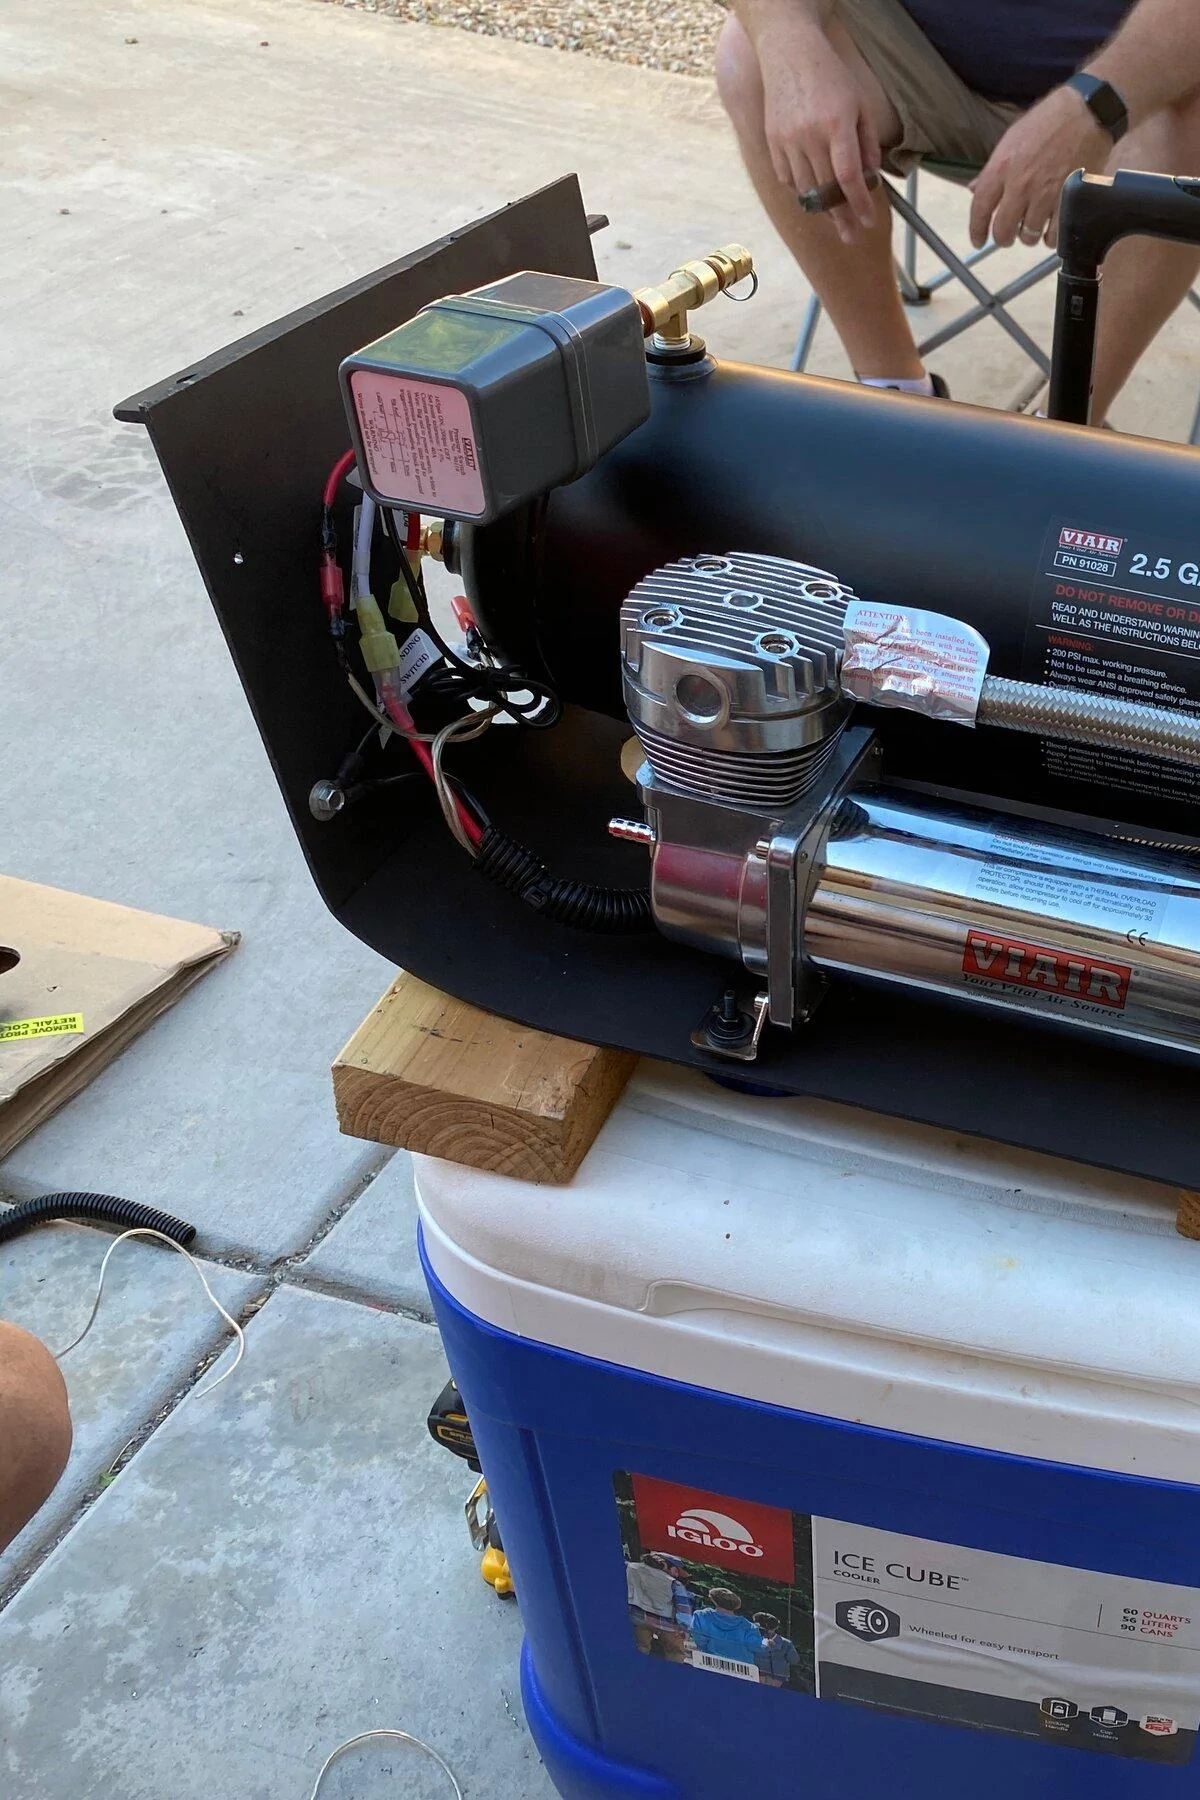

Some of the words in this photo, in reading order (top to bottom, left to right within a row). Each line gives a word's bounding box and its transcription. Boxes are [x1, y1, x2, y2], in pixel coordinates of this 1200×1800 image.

[1062, 530, 1120, 552] VIAIR
[1062, 555, 1076, 566] PN
[1078, 559, 1108, 572] 91028
[1129, 551, 1172, 580] 2.5
[1055, 584, 1076, 597] DO
[1078, 588, 1105, 603] NOT
[1108, 594, 1163, 615] REMOVE
[1165, 606, 1186, 619] OR
[1051, 602, 1076, 614] READ
[1077, 607, 1098, 618] AND
[1099, 611, 1161, 631] UNDERSTAND
[1051, 613, 1077, 625] WELL
[1077, 618, 1091, 628] AS
[1092, 621, 1111, 632] THE
[1112, 625, 1179, 646] INSTRUCTIONS
[854, 618, 878, 628] Leader
[934, 632, 965, 645] installed
[1048, 634, 1095, 652] WARNING:
[1050, 659, 1065, 668] Not
[1066, 662, 1073, 670] to
[1075, 664, 1085, 673] be
[1086, 666, 1105, 677] used
[1123, 674, 1159, 689] breathing
[1160, 681, 1187, 694] device.
[1052, 647, 1066, 657] 200
[1067, 650, 1081, 660] PSI
[1081, 655, 1100, 664] max.
[1101, 657, 1132, 672] working
[1132, 665, 1168, 679] pressure.
[1049, 670, 1076, 682] Always
[1077, 677, 1096, 686] wear
[1096, 679, 1117, 690] ANSI
[1117, 684, 1153, 699] approved
[1154, 691, 1178, 703] safety
[970, 939, 1123, 1001] VIAIR
[961, 973, 997, 988] Your
[1001, 983, 1038, 998] Vital
[1041, 992, 1065, 1004] Air
[1070, 1001, 1125, 1018] Source
[32, 1024, 77, 1034] REMOVE
[33, 1017, 76, 1027] RETAIL
[667, 1525, 764, 1557] IGLOO
[833, 1569, 880, 1585] COOLER
[834, 1551, 875, 1572] ICE
[885, 1563, 960, 1590] CUBE
[1120, 1623, 1136, 1632] 90
[1140, 1627, 1174, 1638] CANS
[1122, 1616, 1137, 1624] 56
[1141, 1619, 1179, 1631] LITERS
[1142, 1611, 1192, 1624] QUARTS
[909, 1624, 957, 1641] Wheeled
[960, 1635, 977, 1644] for
[979, 1640, 1005, 1651] easy
[1008, 1644, 1060, 1660] transport
